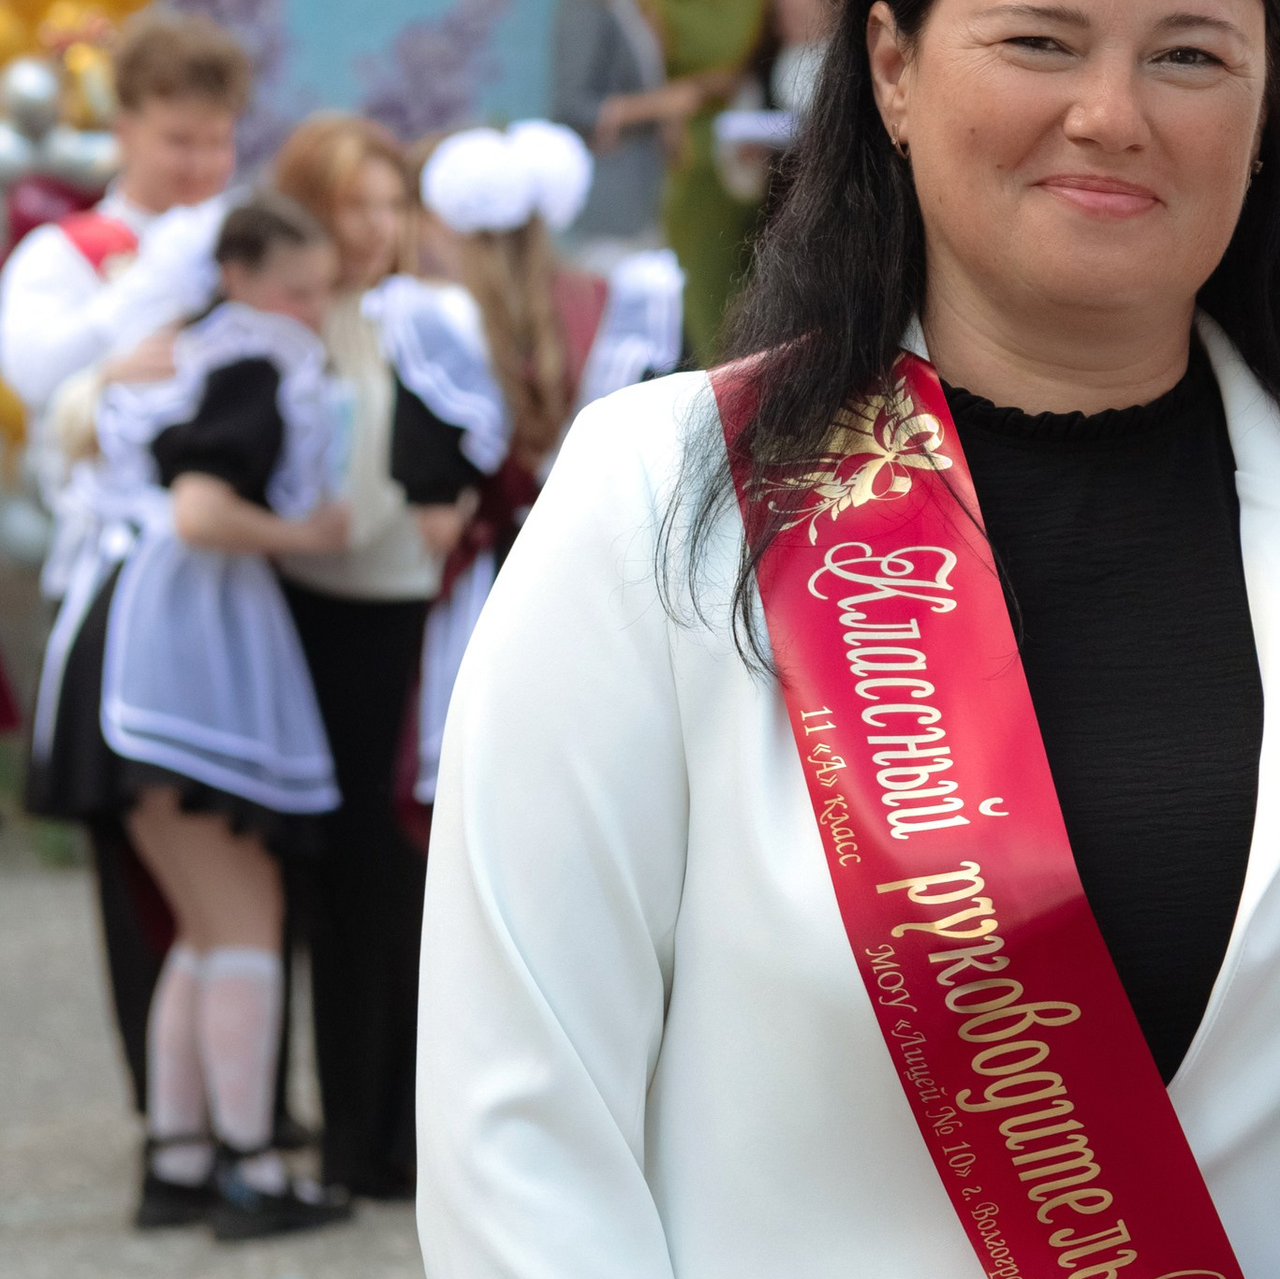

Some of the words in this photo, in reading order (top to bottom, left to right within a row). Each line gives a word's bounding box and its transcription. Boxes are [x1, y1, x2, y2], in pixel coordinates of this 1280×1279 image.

[806, 541, 1009, 840] Классный
[800, 705, 837, 736] 11
[807, 743, 847, 787] «А»
[819, 794, 861, 867] класс
[865, 944, 918, 1013] МОУ
[891, 1019, 948, 1103] «Лицей
[925, 1106, 963, 1136] №
[942, 1141, 976, 1177] 10»
[961, 1185, 982, 1201] г.
